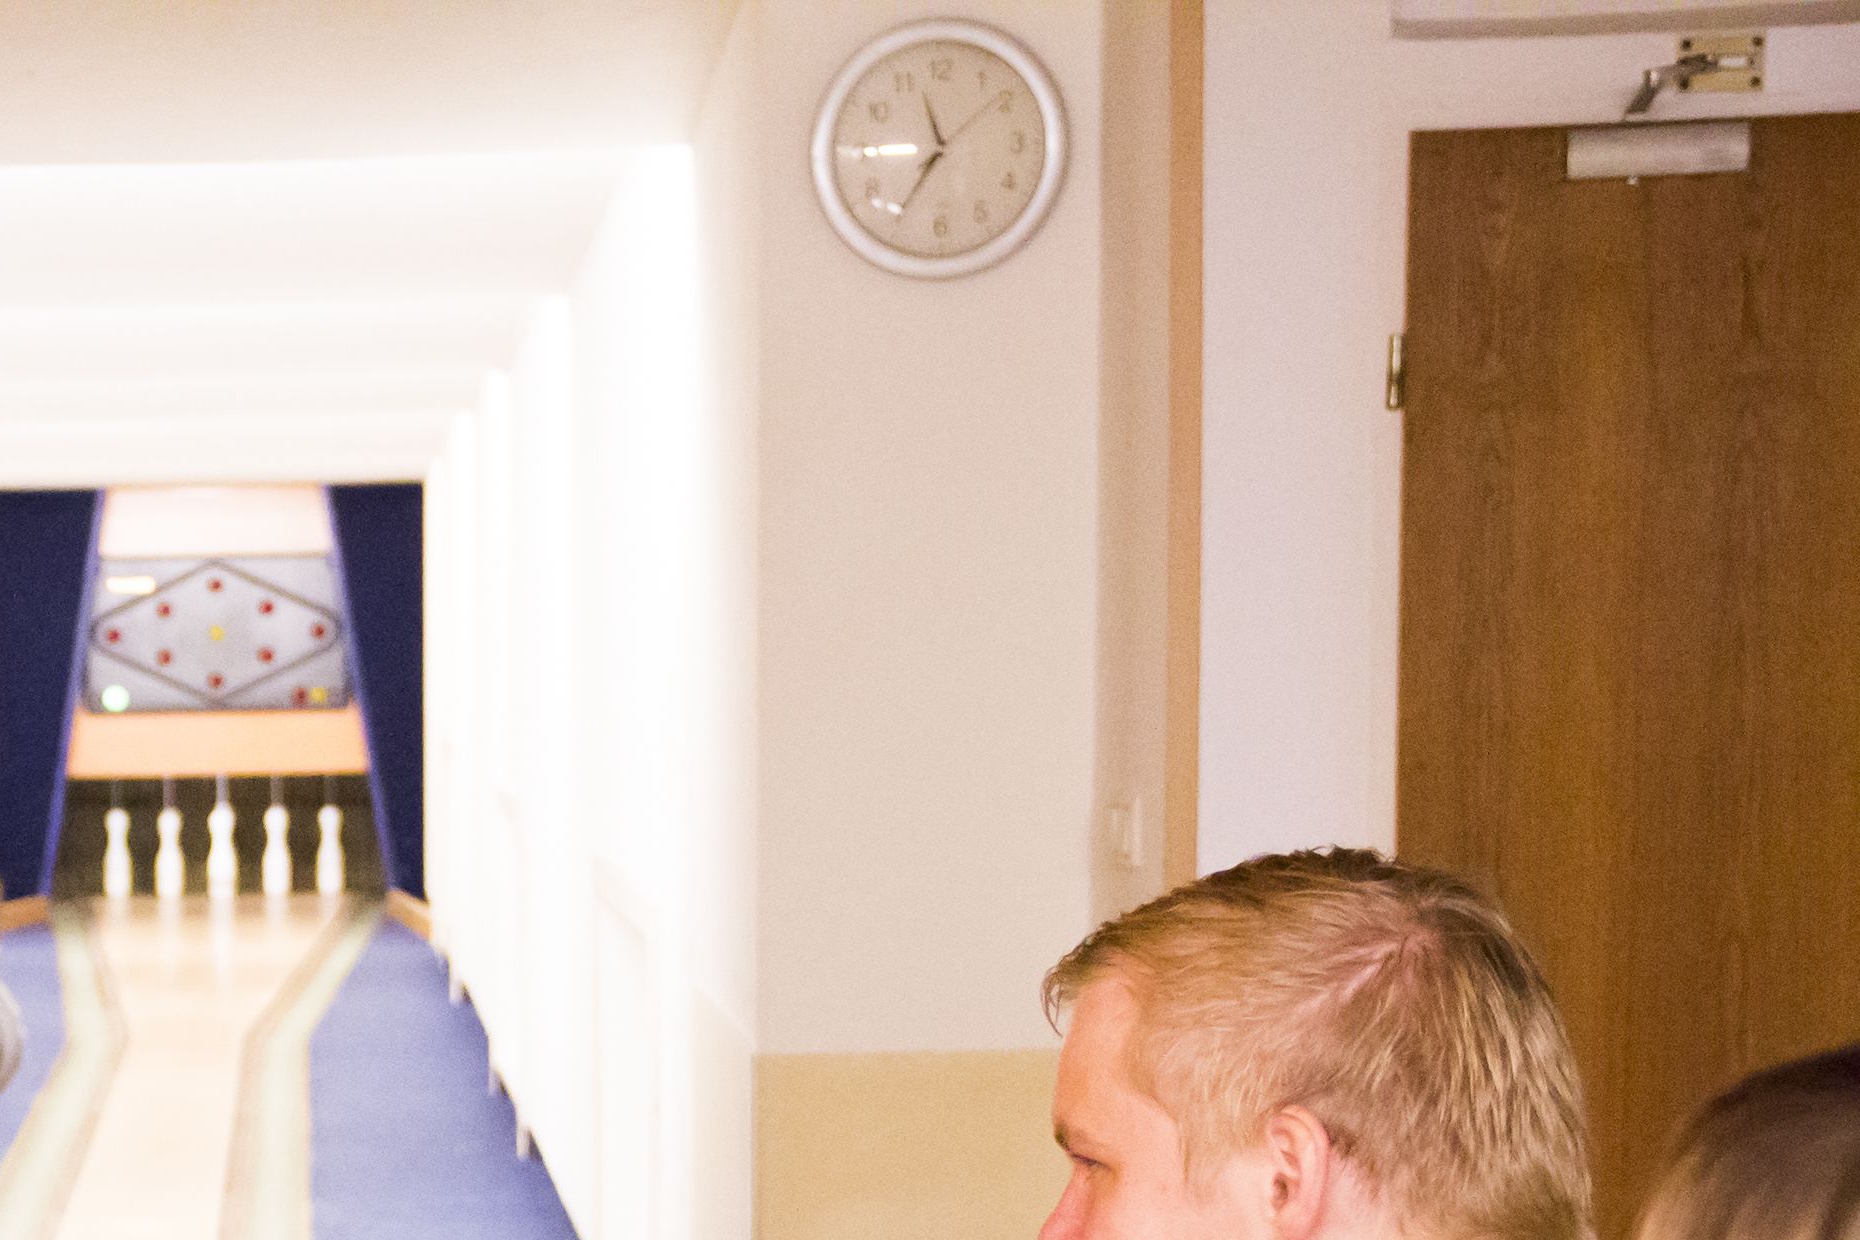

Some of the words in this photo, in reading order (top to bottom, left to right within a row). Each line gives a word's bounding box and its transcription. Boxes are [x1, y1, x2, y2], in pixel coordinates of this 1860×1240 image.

[893, 70, 915, 93] 11
[930, 57, 954, 82] 12
[868, 100, 891, 124] 10
